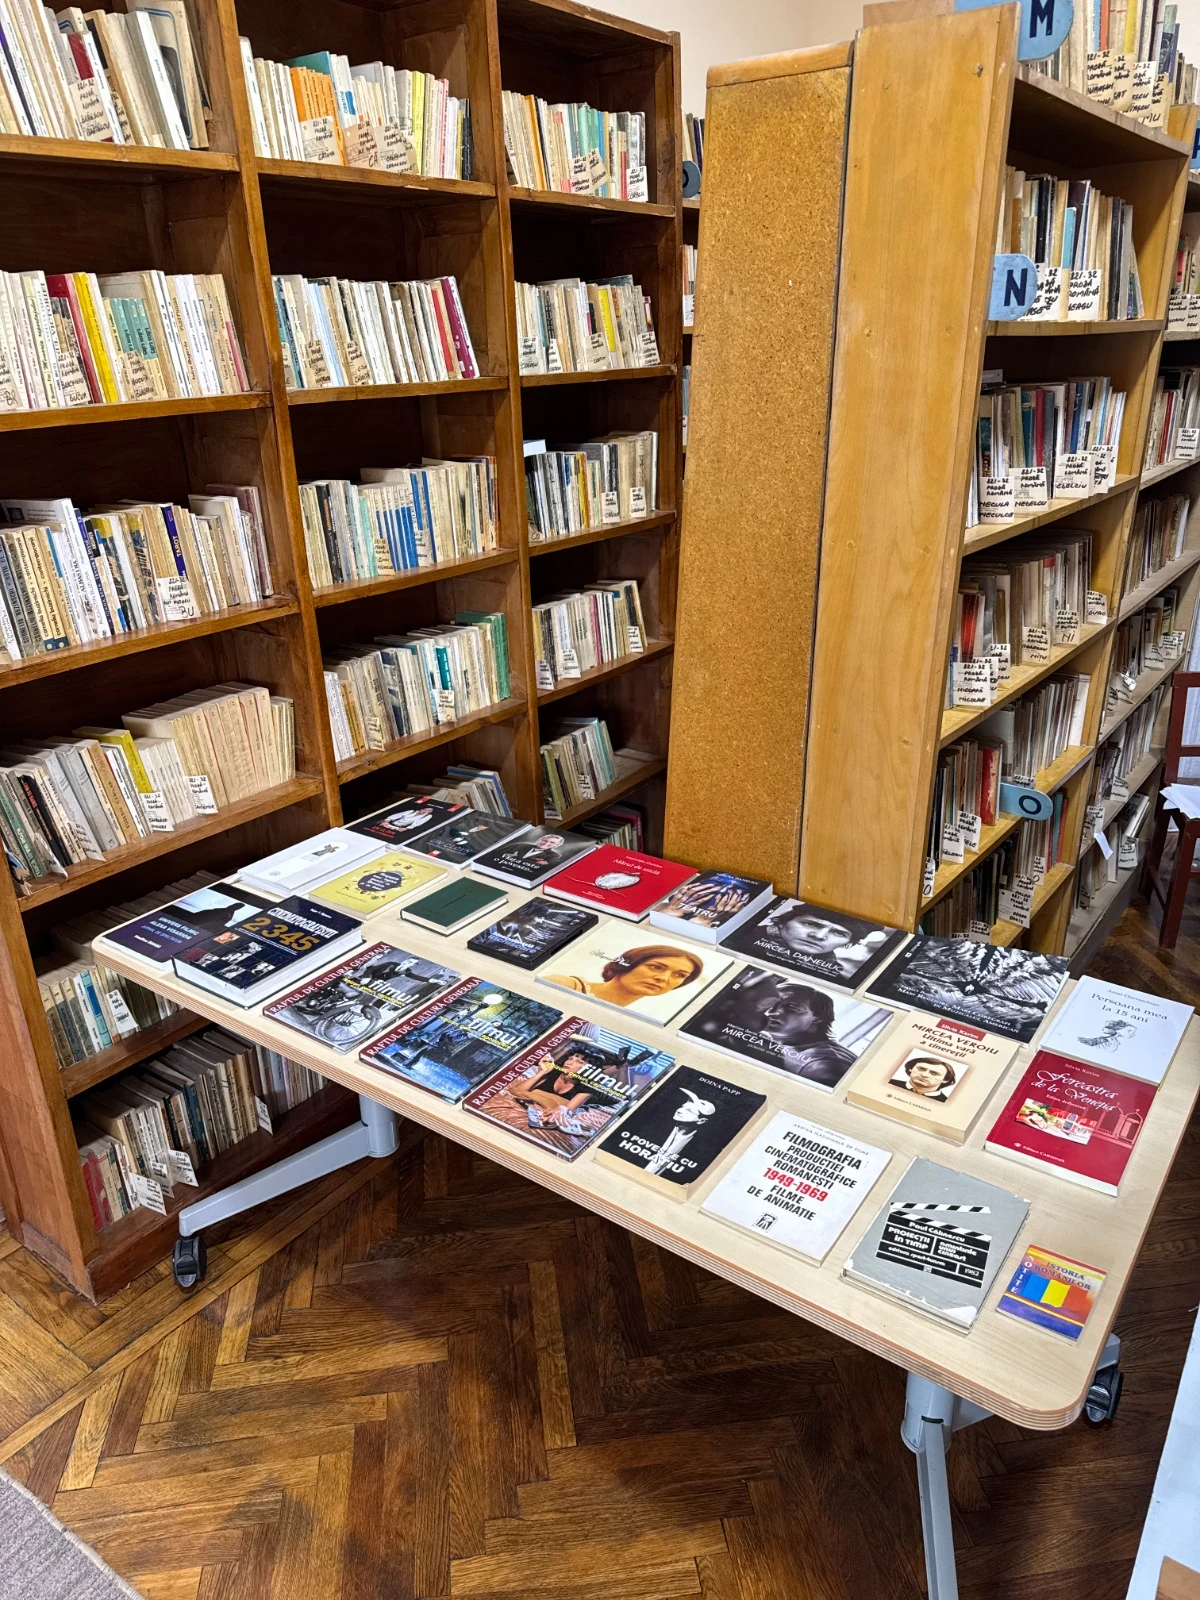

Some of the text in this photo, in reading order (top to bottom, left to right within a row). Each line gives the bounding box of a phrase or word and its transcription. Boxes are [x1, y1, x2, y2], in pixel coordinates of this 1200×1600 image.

[1030, 0, 1054, 38] M
[1004, 268, 1028, 306] N
[1019, 795, 1042, 814] O
[678, 903, 717, 918] TEATRU
[754, 940, 791, 956] MIRCEA
[269, 990, 304, 1016] RAFTUL
[302, 984, 316, 996] DE
[368, 980, 419, 1004] filmul
[1091, 993, 1141, 1014] Persoana
[1143, 1008, 1168, 1020] mea
[1101, 1005, 1148, 1024] la 15 ani
[366, 1029, 402, 1059] RAFTUL
[400, 1022, 414, 1035] DE
[468, 1018, 524, 1046] filmul
[722, 1027, 764, 1046] MIRCEA
[768, 1042, 812, 1063] VEROIU
[912, 1023, 1000, 1055] MIRCEA VEROIU
[923, 1033, 976, 1055] Ultima vară
[472, 1077, 507, 1109] RAFTUL
[504, 1069, 519, 1083] DE
[577, 1063, 638, 1096] filmul
[697, 1076, 741, 1096] DOINA PAPP
[1031, 1079, 1047, 1089] de
[1047, 1083, 1059, 1093] la
[1036, 1070, 1120, 1100] Fereastra
[620, 1130, 698, 1169] O POVESTE CU
[782, 1131, 863, 1170] FILMOGRAFIA
[764, 1144, 858, 1189] CINEMATOGRAFICE
[747, 1185, 763, 1198] DE
[763, 1167, 829, 1203] 1949-1969
[770, 1184, 805, 1204] FILME
[909, 1221, 928, 1232] Paul
[964, 1267, 980, 1278] 1982
[1045, 1261, 1085, 1280] ISTORIA
